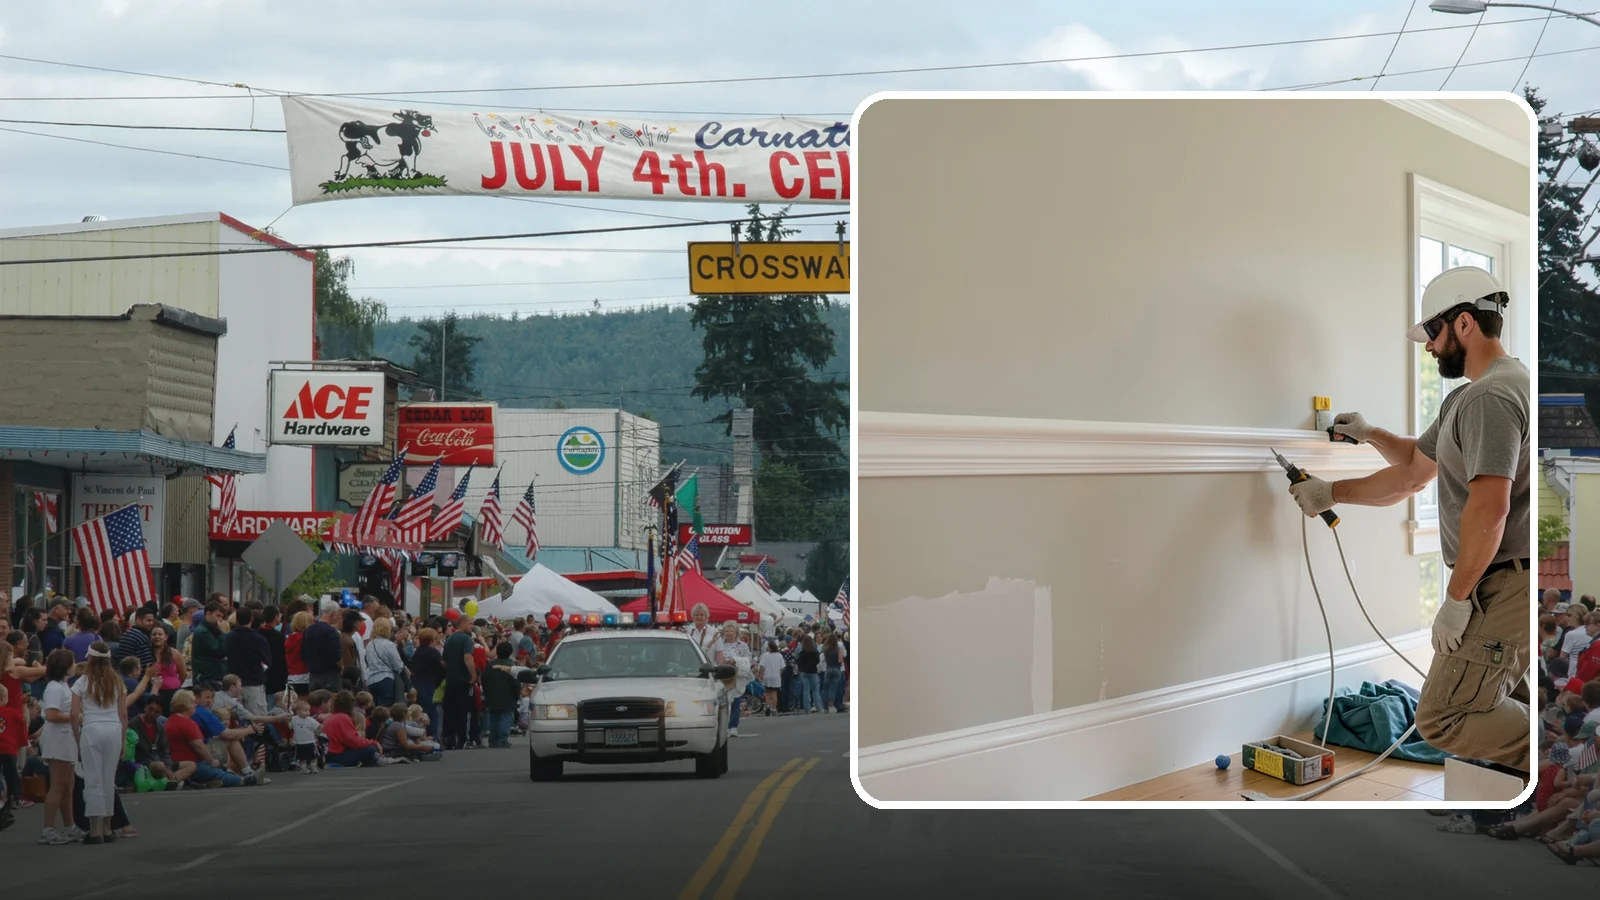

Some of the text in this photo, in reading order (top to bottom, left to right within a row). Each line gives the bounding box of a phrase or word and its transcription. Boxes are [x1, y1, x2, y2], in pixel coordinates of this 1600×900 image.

[481, 141, 605, 192] JULY
[632, 149, 746, 198] 4th.
[697, 254, 850, 280] CROSSWA
[282, 380, 374, 420] ACE
[406, 409, 485, 421] CEDAR LOG
[283, 421, 371, 436] Hardware
[416, 428, 477, 447] Coca-Cola
[353, 467, 384, 480] Simpl
[95, 485, 124, 495] Vincent
[126, 485, 135, 494] de
[137, 486, 155, 495] Paul
[81, 503, 154, 522] THRT
[688, 526, 741, 535] CRNATION
[699, 535, 730, 543] GLASS
